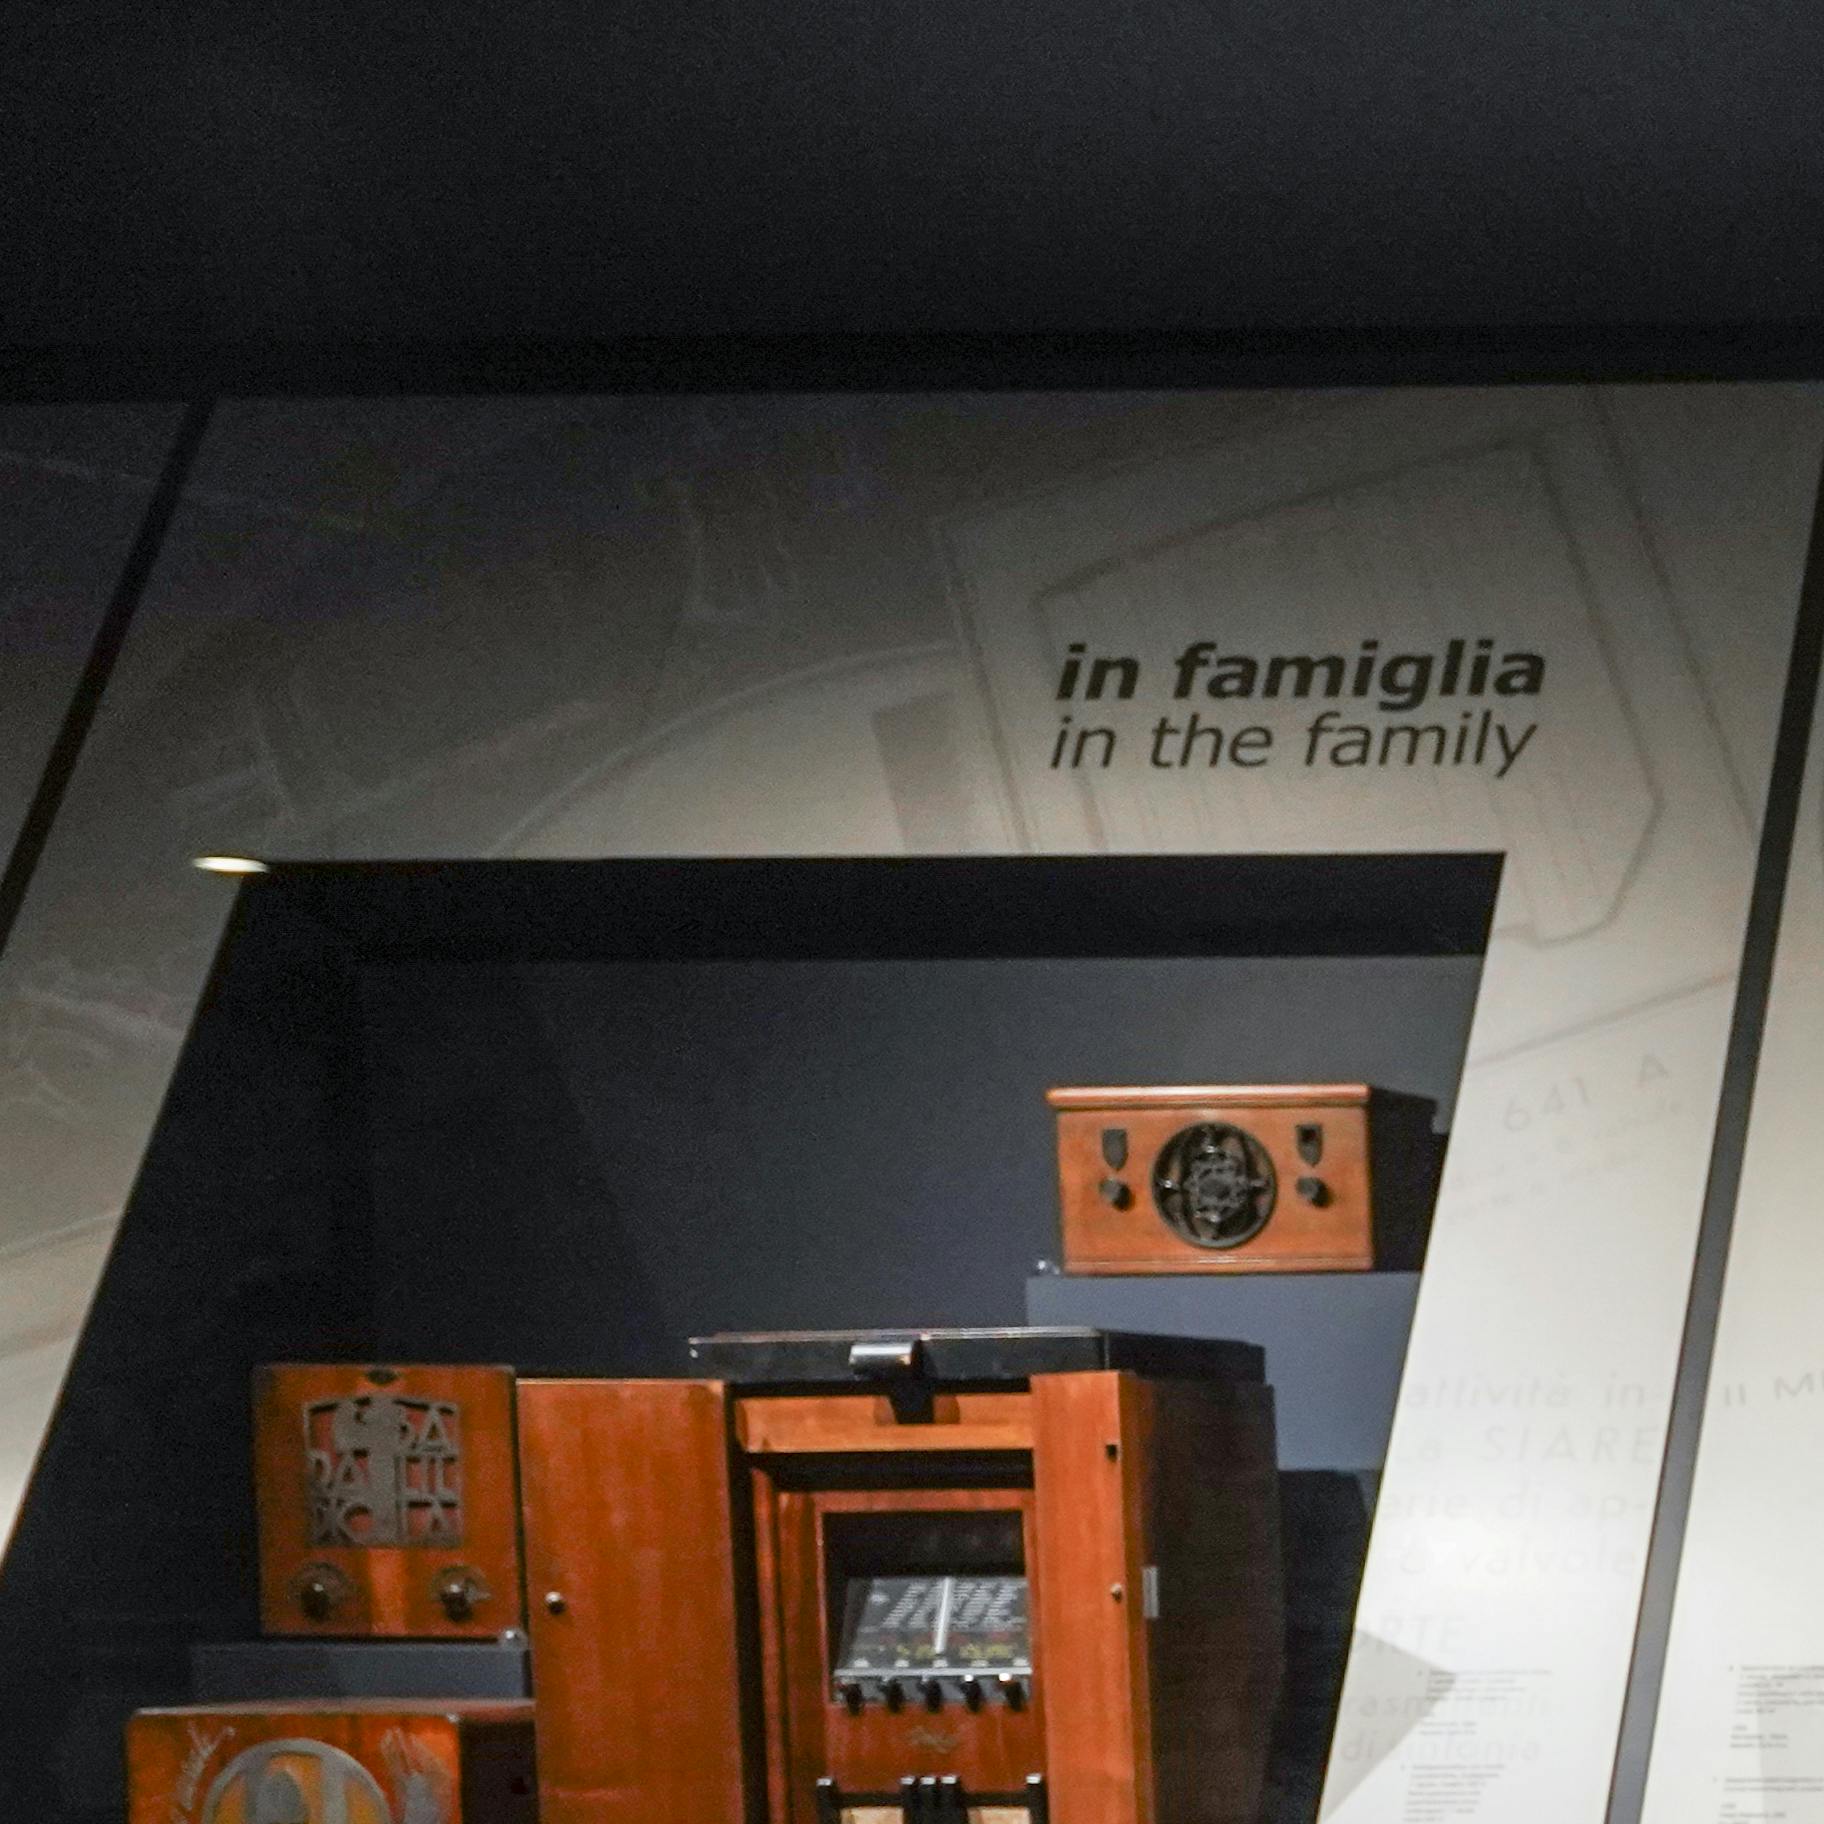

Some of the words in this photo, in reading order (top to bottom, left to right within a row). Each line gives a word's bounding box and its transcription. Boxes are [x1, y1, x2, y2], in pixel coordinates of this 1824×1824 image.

[1055, 643, 1139, 701] in
[1173, 639, 1546, 712] famiglia
[1050, 714, 1116, 770] in
[1150, 713, 1273, 769] the
[1303, 709, 1538, 778] family
